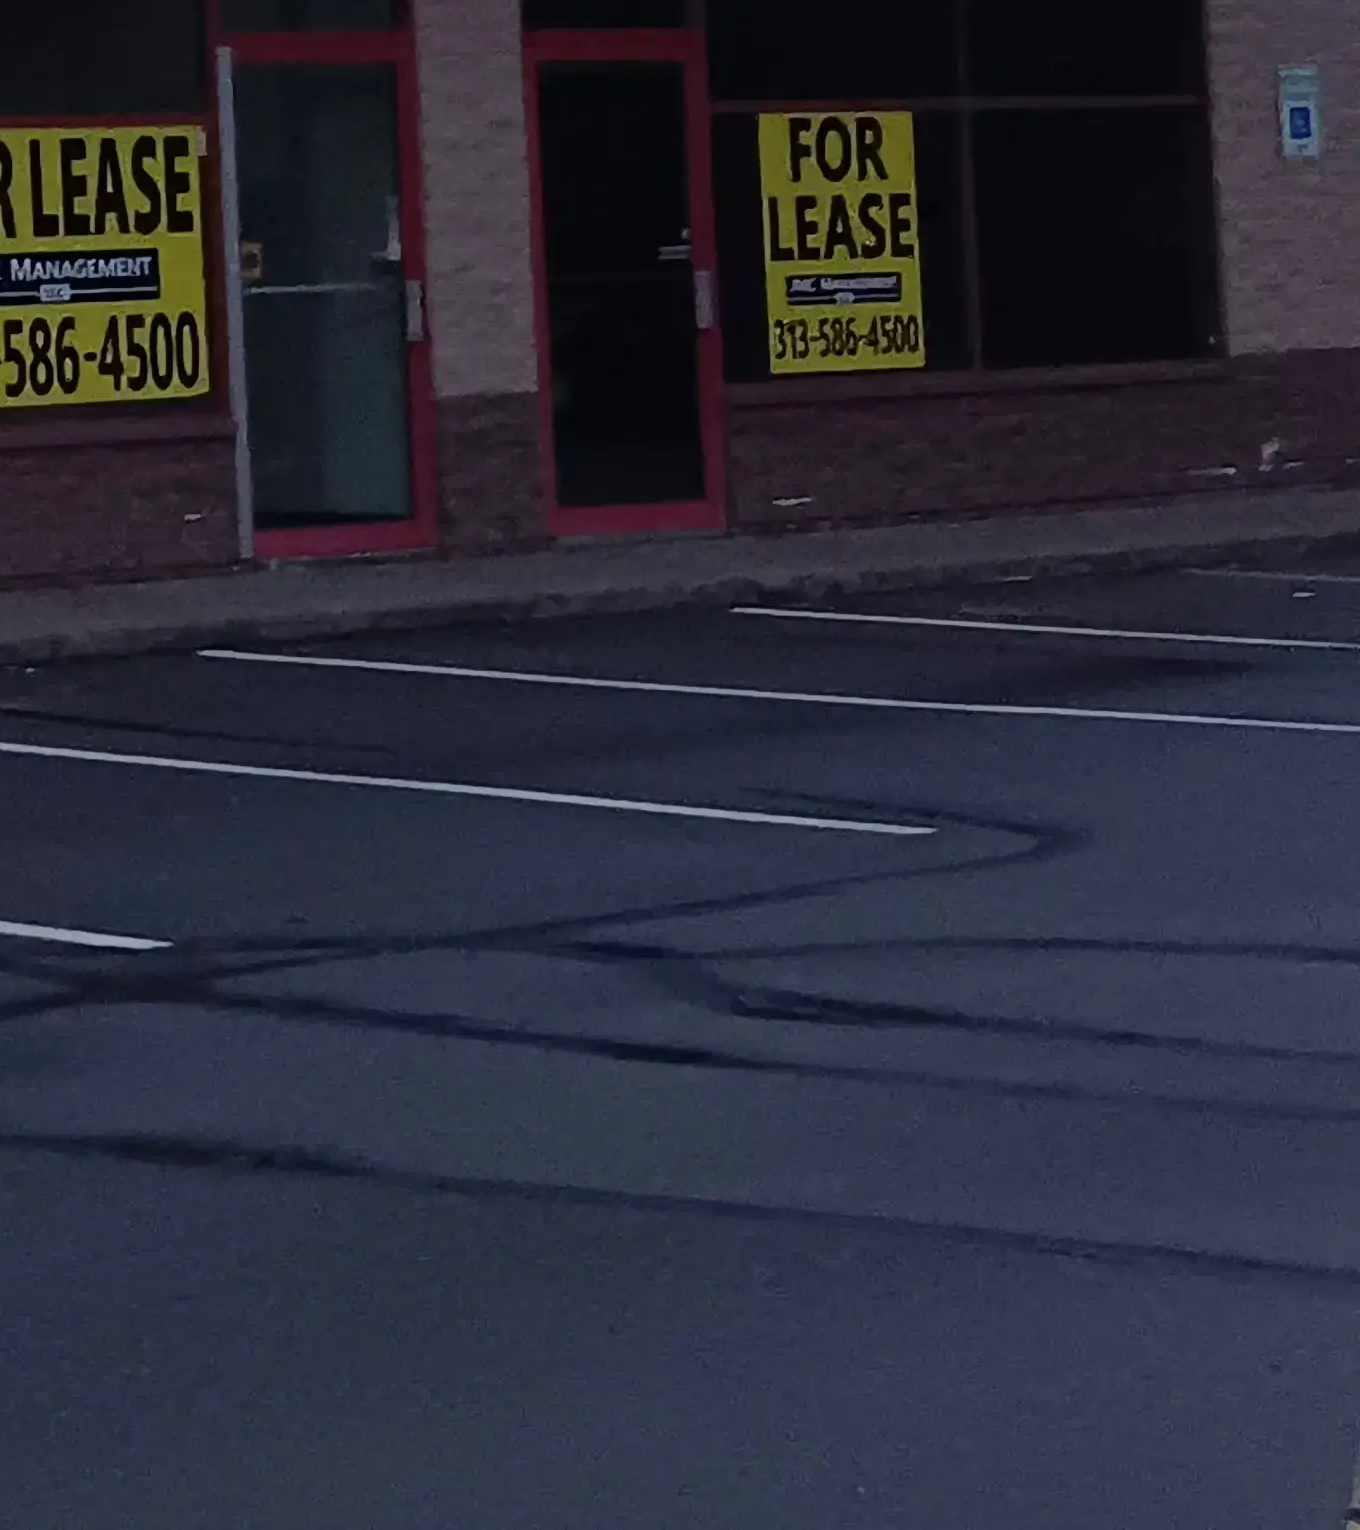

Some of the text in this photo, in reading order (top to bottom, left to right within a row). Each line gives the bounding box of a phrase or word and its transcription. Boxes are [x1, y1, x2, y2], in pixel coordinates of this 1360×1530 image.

[789, 116, 889, 182] FOR
[29, 135, 194, 237] LEASE
[768, 193, 915, 262] LEASE
[10, 256, 153, 282] MANAGEMENT
[773, 315, 920, 360] 313-586-4500
